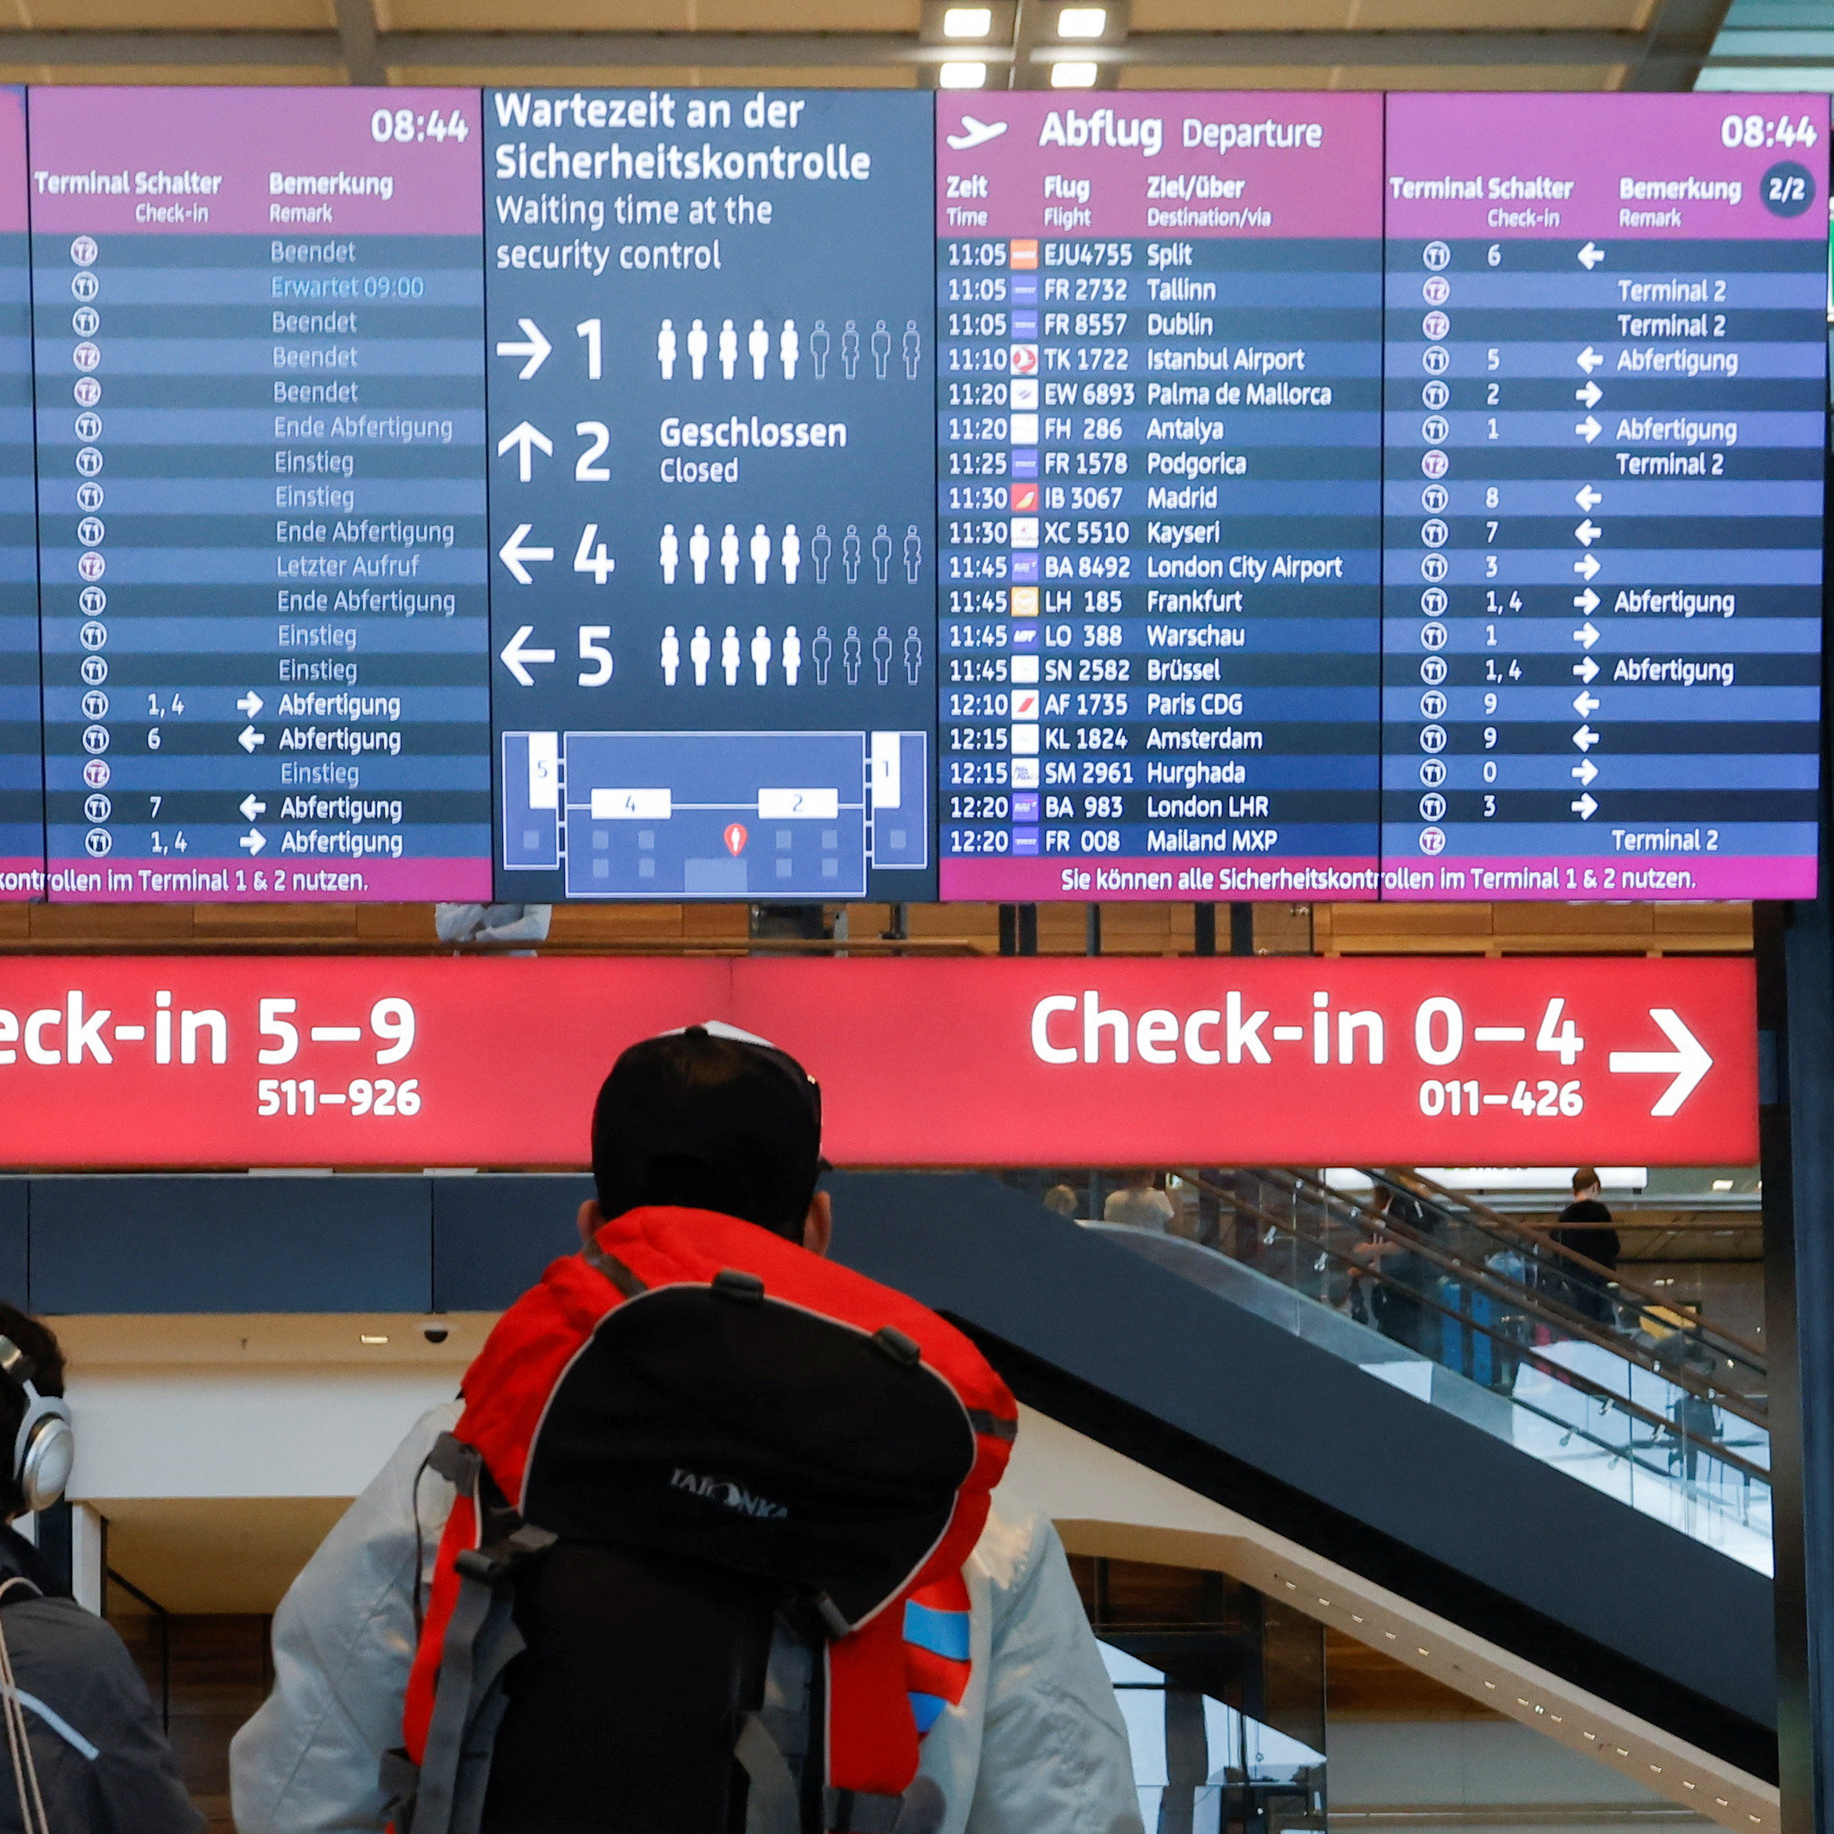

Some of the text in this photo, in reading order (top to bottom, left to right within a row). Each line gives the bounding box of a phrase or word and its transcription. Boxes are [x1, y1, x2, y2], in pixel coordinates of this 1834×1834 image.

[371, 109, 469, 142] 08:44
[495, 95, 805, 128] Wartezeit an der
[1039, 109, 1322, 156] Abflug Departure
[1722, 115, 1817, 147] 08:44
[496, 143, 870, 179] Sicherheitskontrolle
[34, 170, 130, 194] Terminal
[134, 171, 222, 195] Schalter
[270, 171, 393, 200] Bemerkung
[947, 174, 1742, 207] Zeit Flug Ziel/über Terminal Schalter Bemerkung
[1769, 176, 1805, 204] 2/2
[135, 203, 209, 223] Check-in
[270, 203, 332, 223] Remark
[496, 195, 773, 228] Waiting time at the
[947, 207, 1682, 231] Time Flight Destination/via Check-in Remark
[271, 239, 356, 262] Beendet
[497, 243, 722, 276] security control
[576, 318, 602, 380] 1
[949, 348, 1008, 371] 11:10
[1044, 348, 1071, 371] TK
[1078, 348, 1129, 371] 1722
[1148, 347, 1228, 371] Istanbul
[1234, 347, 1306, 376] Airport
[1487, 348, 1500, 371] 5
[1616, 347, 1739, 376] Abfertigung
[949, 416, 1738, 446] 11:20 FH 286 Antalya 1 Abfertigung
[575, 415, 847, 482] 2 Geschlossen
[660, 456, 739, 483] Closed
[573, 523, 615, 585] 4
[578, 625, 614, 687] 5
[148, 727, 161, 750] 6
[280, 727, 401, 756] Abfertigung
[537, 760, 548, 778] 5
[624, 796, 637, 812] 4
[792, 795, 804, 812] 2
[108, 868, 132, 891] im
[138, 868, 230, 892] Terminal
[236, 870, 247, 891] 1
[254, 870, 269, 892] &
[275, 870, 286, 892] 2
[292, 871, 369, 892] nutzen.
[1031, 991, 1384, 1066] Check-in
